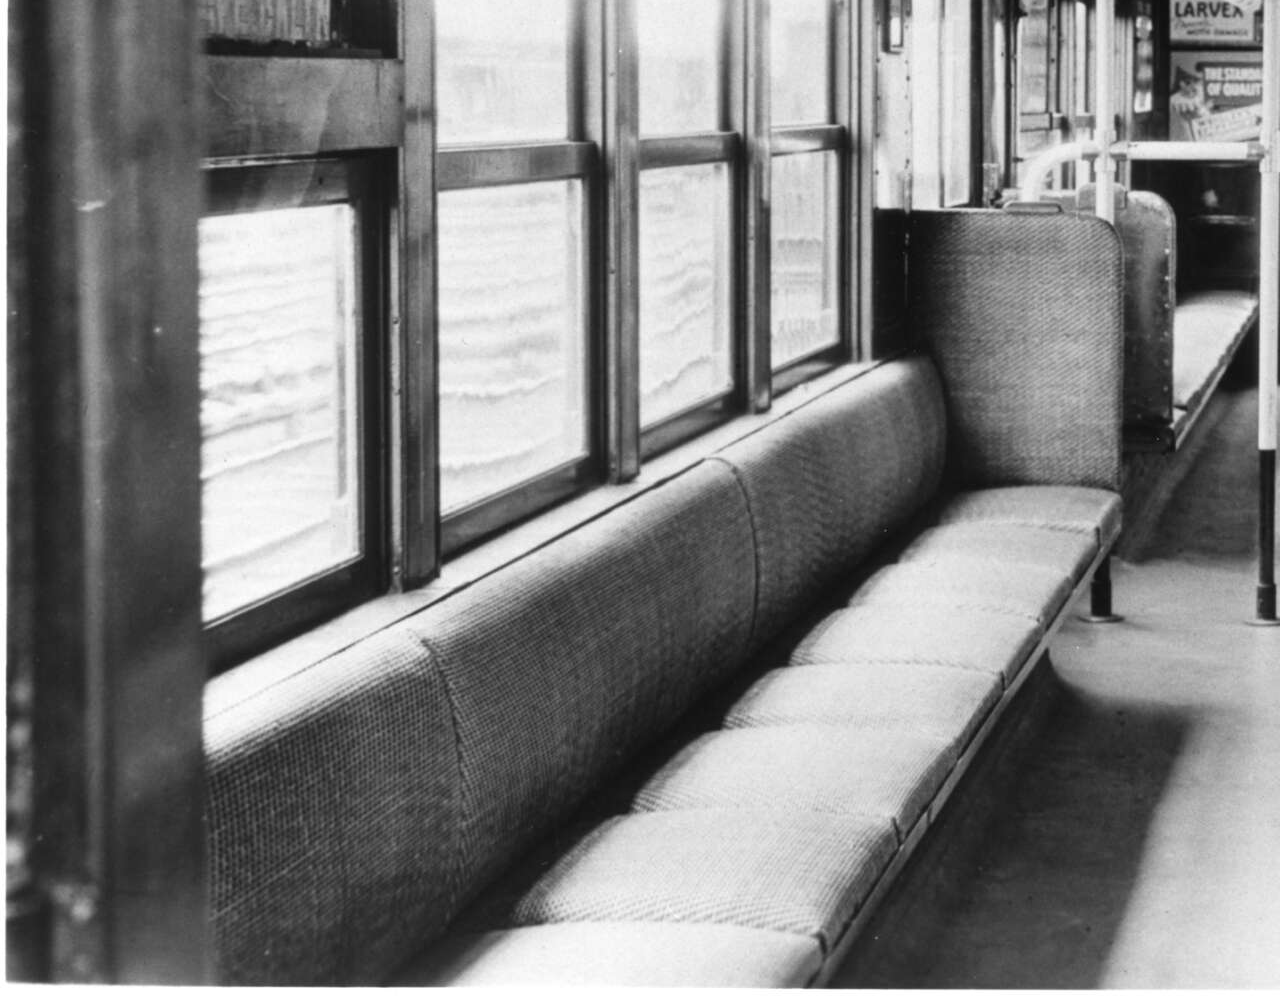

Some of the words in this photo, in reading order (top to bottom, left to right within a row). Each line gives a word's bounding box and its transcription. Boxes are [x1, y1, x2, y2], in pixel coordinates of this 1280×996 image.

[1175, 1, 1245, 19] LARVEX
[1206, 83, 1222, 96] OF
[1222, 83, 1263, 96] QUALIT
